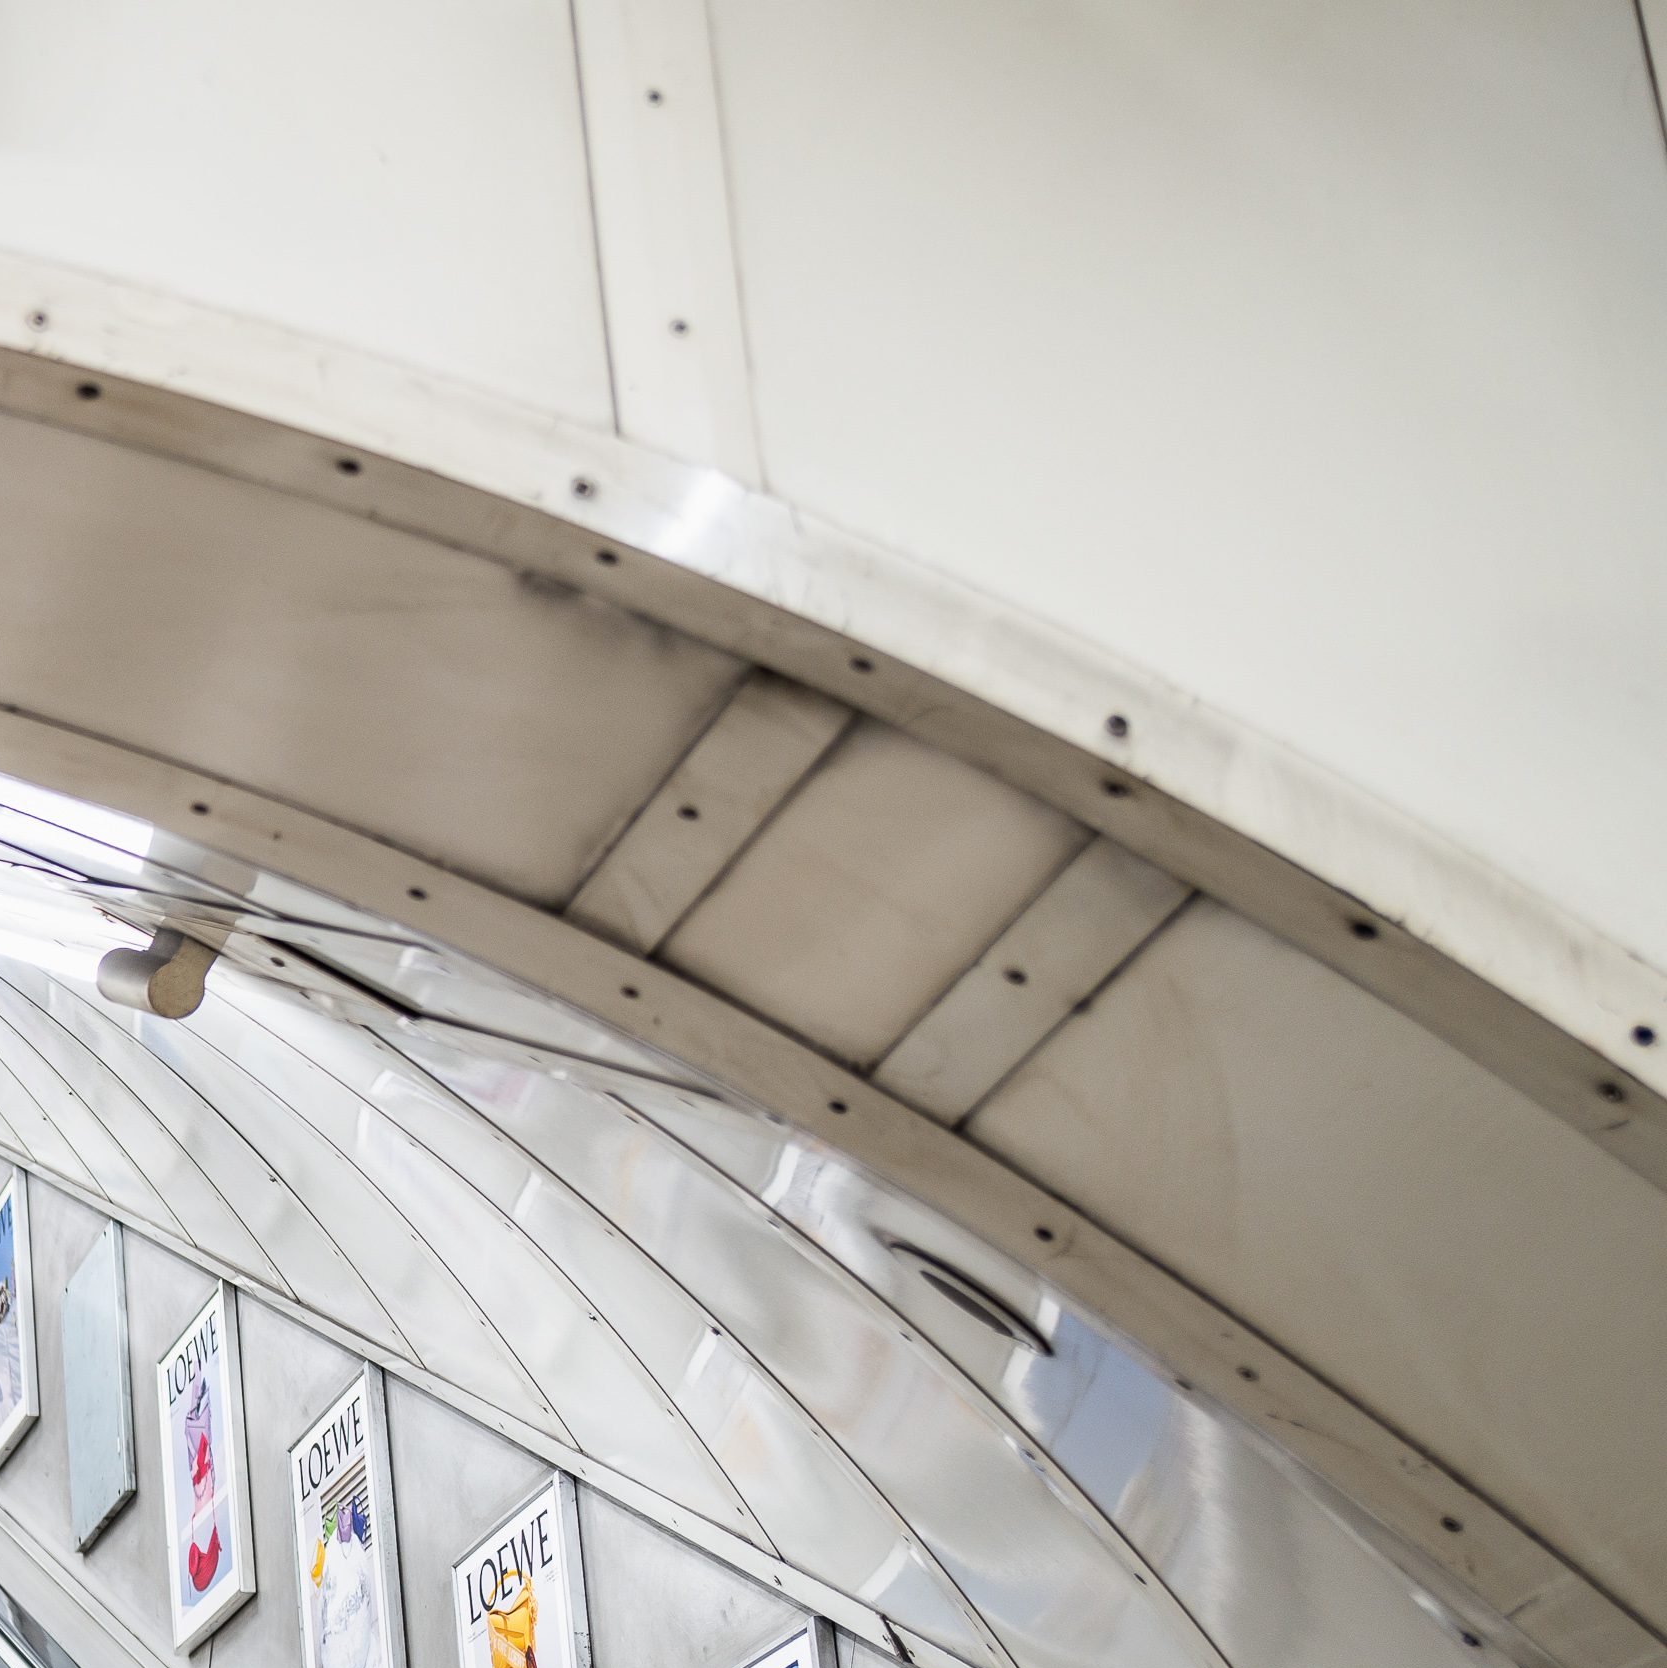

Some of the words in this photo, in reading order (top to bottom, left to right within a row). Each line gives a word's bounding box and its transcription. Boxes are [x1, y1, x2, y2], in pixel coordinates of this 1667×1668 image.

[166, 1309, 219, 1407] LOEWE
[298, 1395, 364, 1503] LOEWE
[465, 1508, 553, 1626] LOEWE
